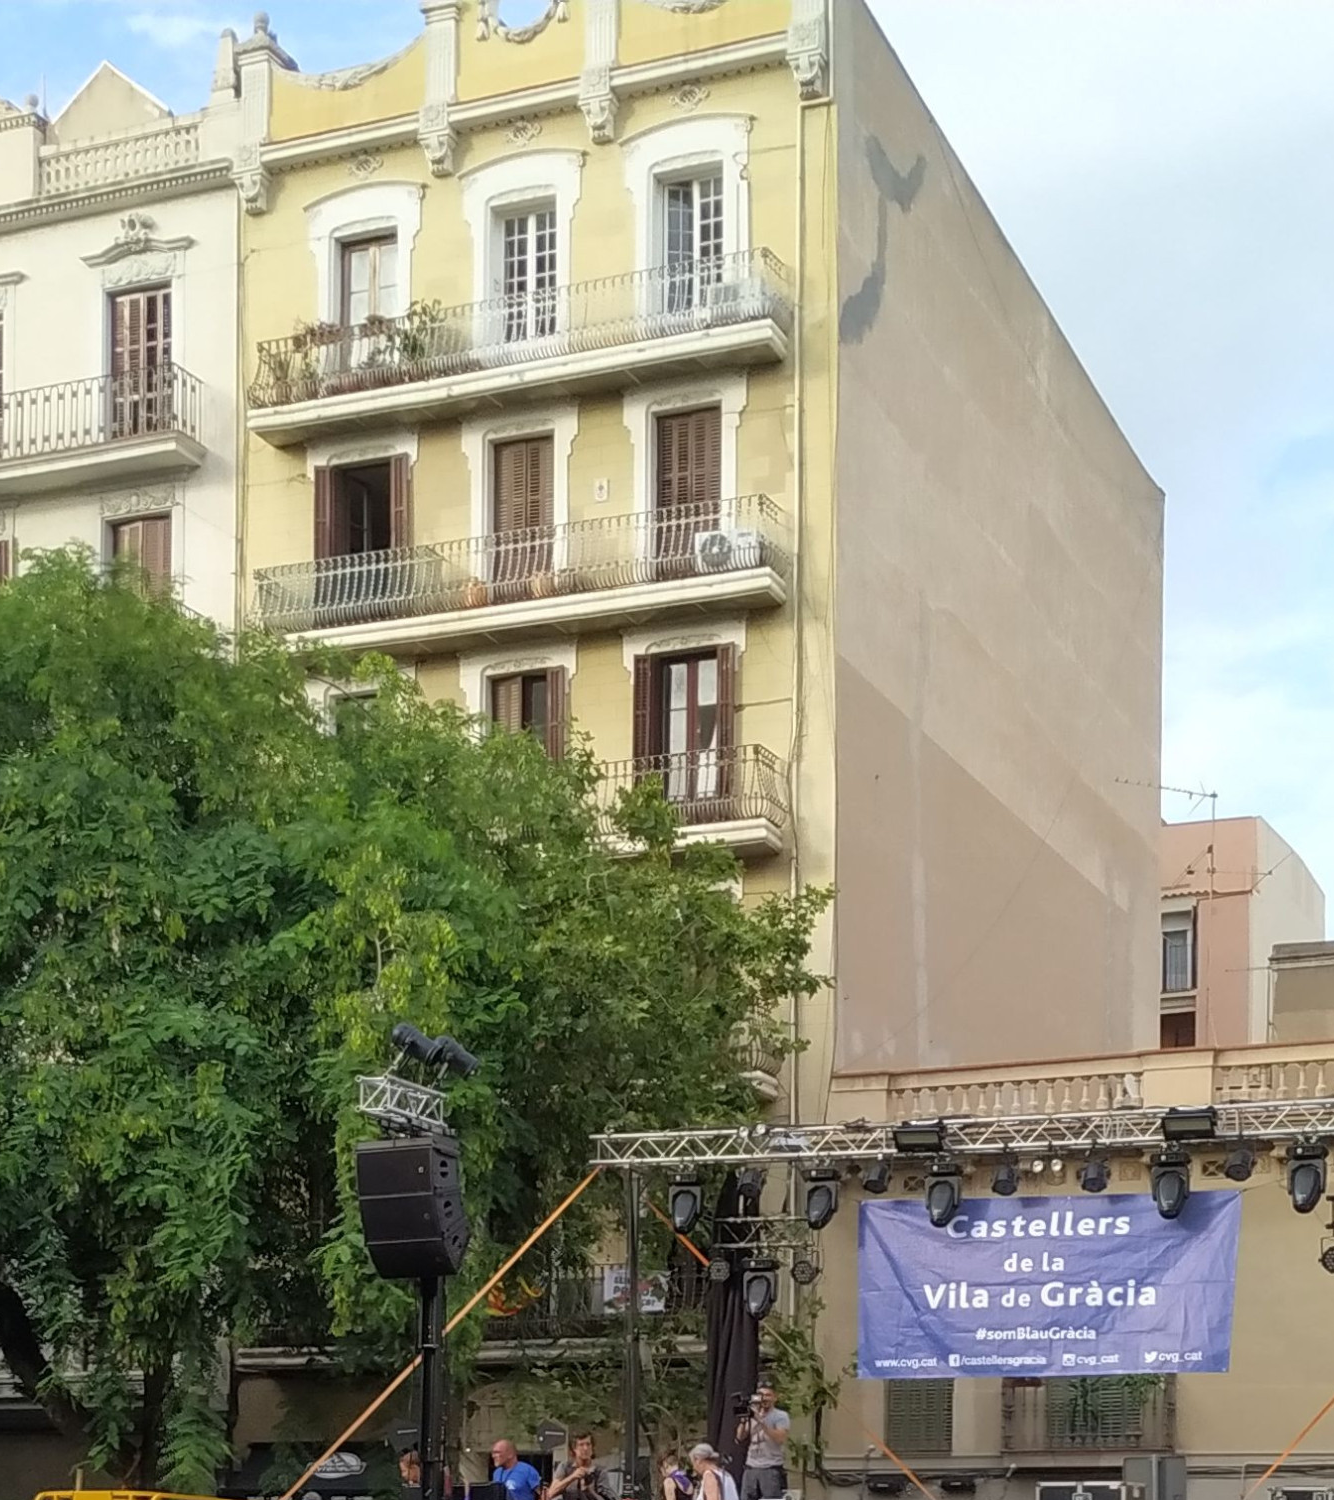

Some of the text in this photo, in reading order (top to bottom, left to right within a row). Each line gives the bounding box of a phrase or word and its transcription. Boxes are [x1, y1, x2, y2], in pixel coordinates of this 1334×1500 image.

[946, 1211, 1131, 1239] Castellers
[1003, 1252, 1065, 1272] de la
[923, 1279, 1157, 1309] Vila de Gràcia
[975, 1326, 1097, 1341] #somBlauGràcia
[874, 1357, 938, 1369] www.cvg.cat
